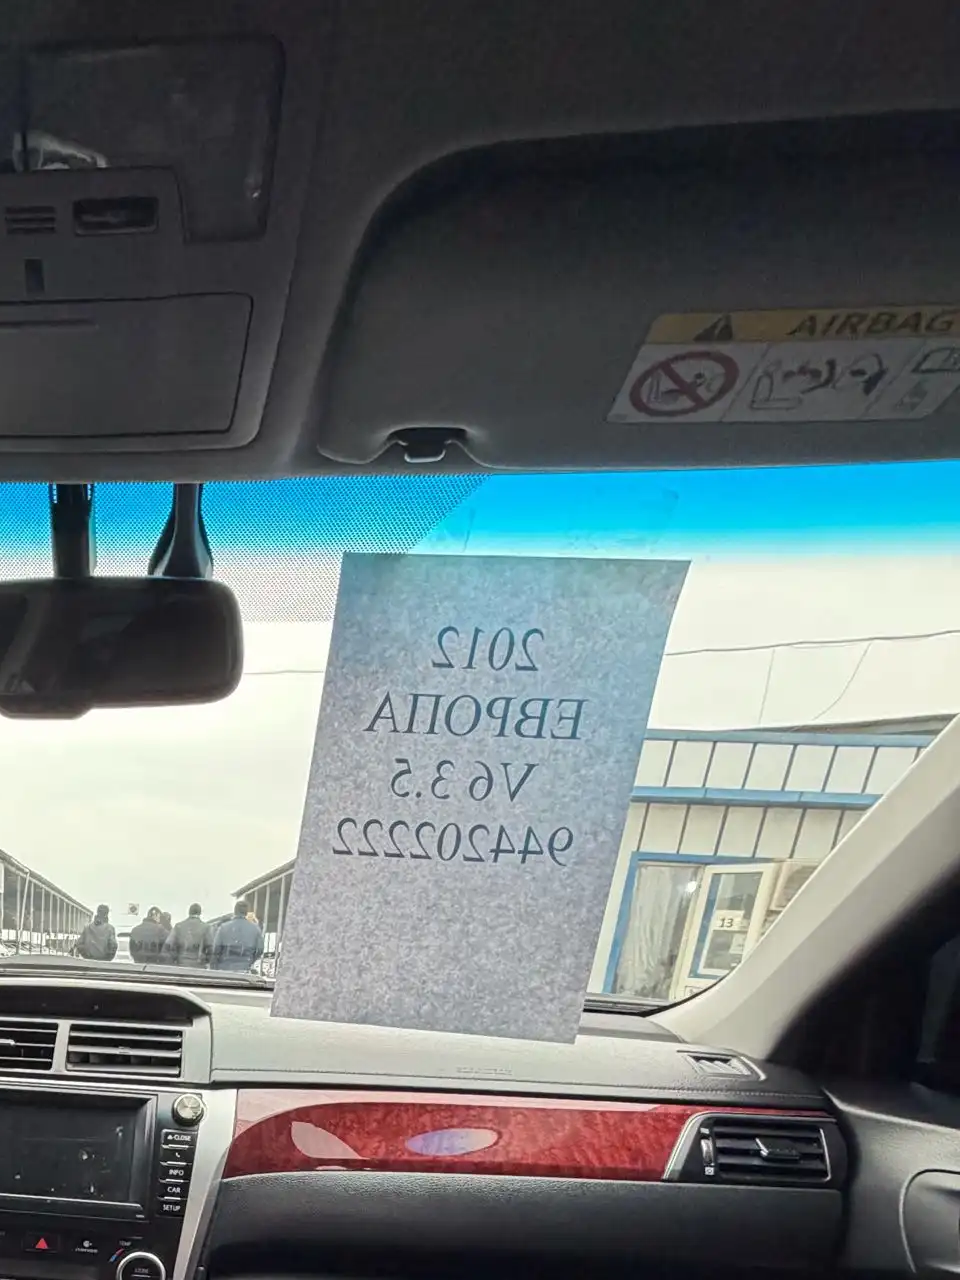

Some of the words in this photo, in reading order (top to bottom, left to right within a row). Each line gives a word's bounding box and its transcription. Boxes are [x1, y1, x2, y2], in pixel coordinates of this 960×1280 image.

[786, 309, 957, 336] AIRBAG
[719, 918, 734, 928] 13
[167, 1186, 181, 1194] CAR
